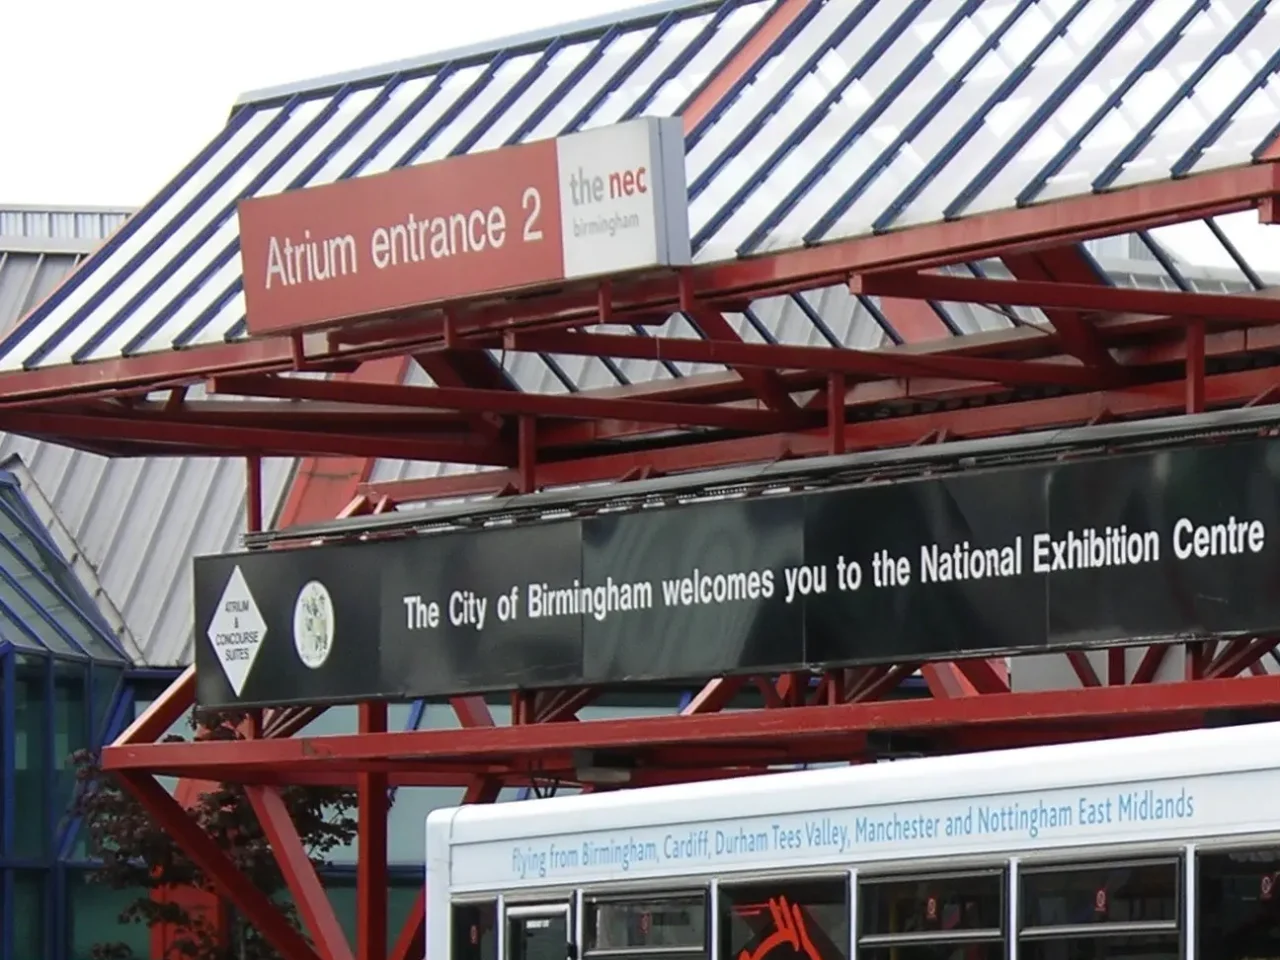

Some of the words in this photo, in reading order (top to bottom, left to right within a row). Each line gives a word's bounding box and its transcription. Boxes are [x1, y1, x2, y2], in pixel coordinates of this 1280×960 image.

[569, 167, 604, 205] the
[609, 166, 647, 199] nec
[265, 230, 357, 289] Atrium
[372, 203, 506, 269] entrance
[522, 187, 543, 241] 2
[573, 212, 640, 239] birmingham
[404, 596, 439, 630] The
[449, 589, 487, 631] City
[498, 585, 518, 621] of
[528, 577, 652, 622] Birmingham
[662, 568, 775, 607] welcomes
[785, 563, 827, 604] you
[838, 555, 862, 592] to
[872, 549, 911, 588] the
[921, 535, 1023, 584] National
[1033, 527, 1160, 574] Exhibition
[1173, 516, 1266, 560] Centre
[215, 631, 259, 646] CONCOURSE
[225, 648, 249, 661] SUITES
[512, 847, 546, 879] flying
[550, 844, 578, 870] from
[582, 838, 660, 871] Birmingham,
[664, 830, 712, 861] Cardiff,
[716, 829, 768, 856] Durham
[772, 824, 801, 851] Tees
[805, 818, 851, 851] Valley,
[855, 813, 940, 843] Manchester
[945, 806, 972, 836] and
[978, 800, 1073, 838] Nottingham
[1079, 797, 1112, 825] East
[1118, 788, 1194, 821] Midlands
